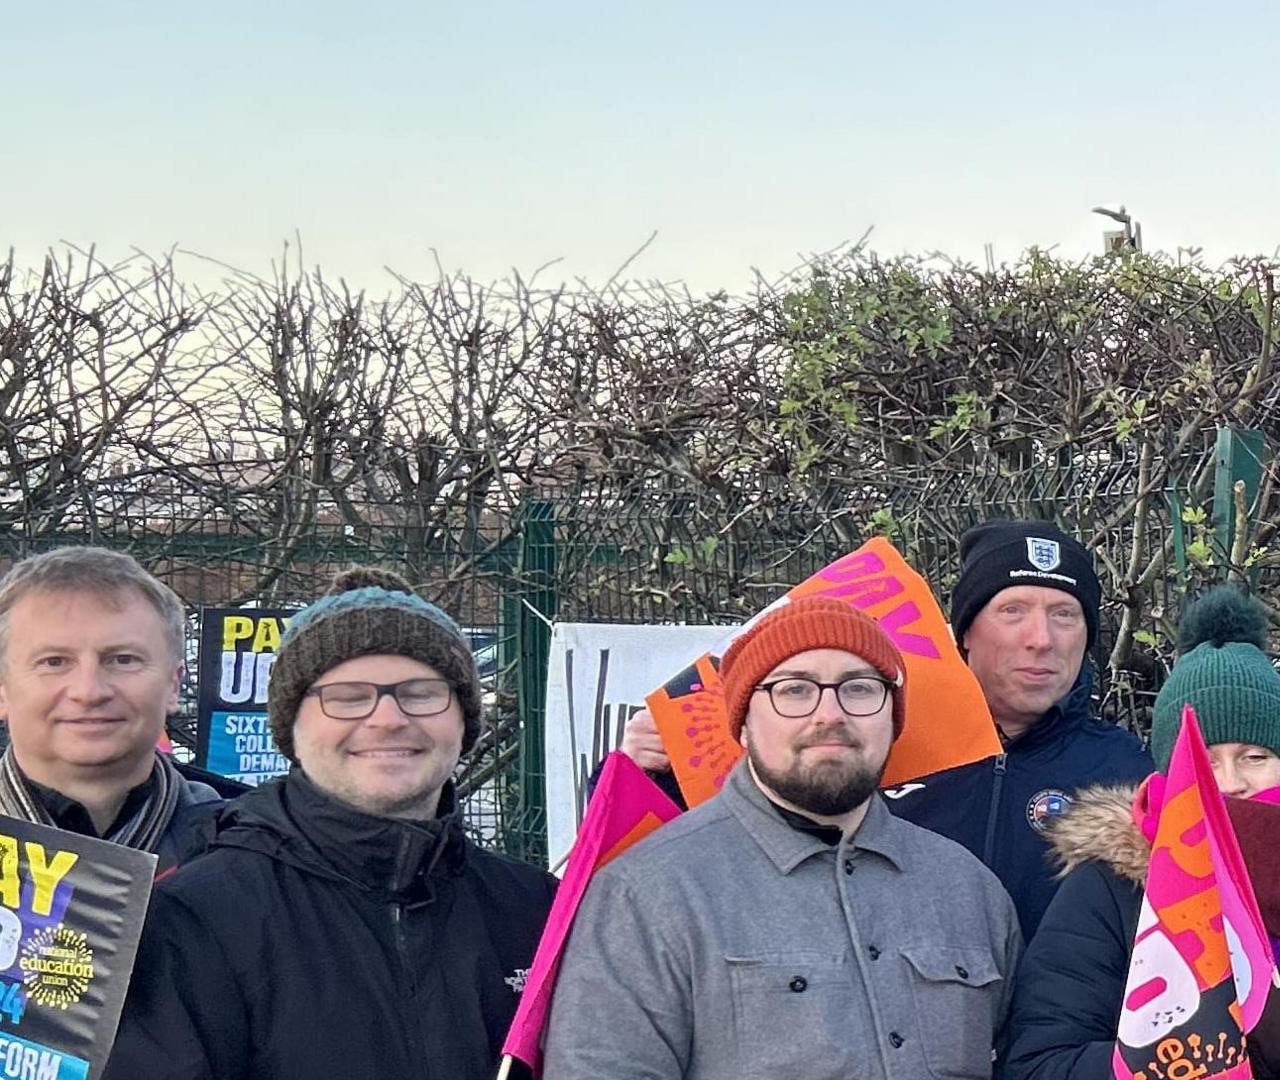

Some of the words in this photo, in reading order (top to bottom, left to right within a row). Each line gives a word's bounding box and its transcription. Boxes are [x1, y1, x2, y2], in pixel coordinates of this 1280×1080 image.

[223, 616, 293, 653] PA
[225, 715, 272, 735] SIXT
[235, 735, 278, 753] COLL
[239, 753, 291, 772] DEMA
[19, 956, 95, 979] education
